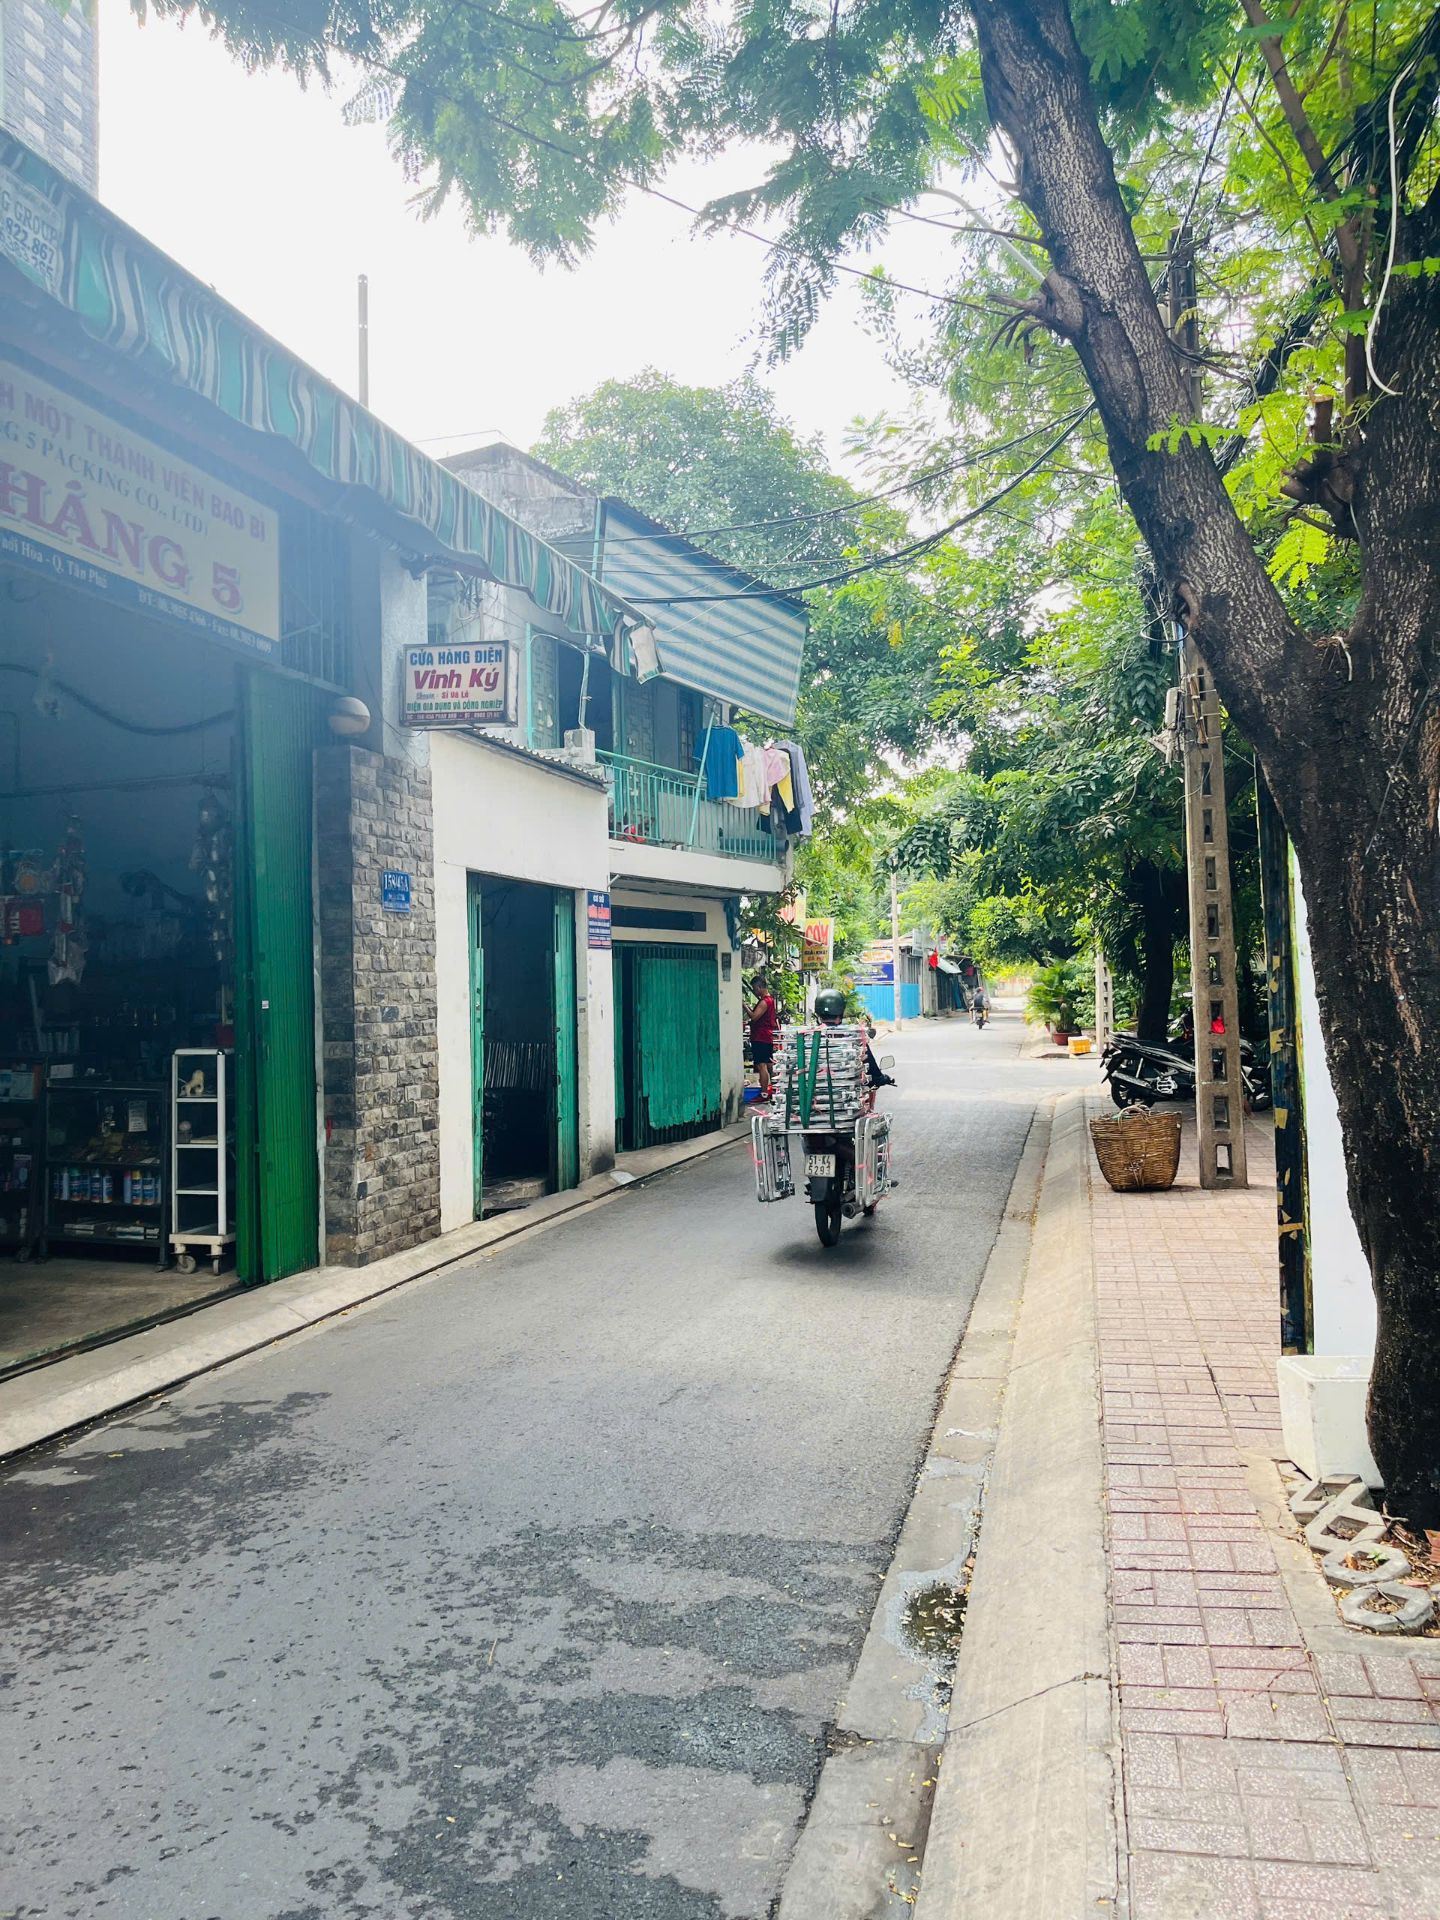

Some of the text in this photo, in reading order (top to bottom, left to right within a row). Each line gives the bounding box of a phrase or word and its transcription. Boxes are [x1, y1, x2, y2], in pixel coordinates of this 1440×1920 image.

[14, 200, 57, 243] GROUP
[25, 391, 75, 440] MỘT
[162, 467, 204, 510] VIÊN
[211, 494, 244, 530] BAO
[25, 432, 36, 449] 5
[42, 438, 130, 497] PACKING
[211, 561, 241, 612] 5
[410, 647, 502, 666] CỬA HÀNG ĐIỆN
[469, 667, 499, 691] Ký
[463, 700, 479, 710] CÔNG
[808, 1166, 831, 1176] 5293
